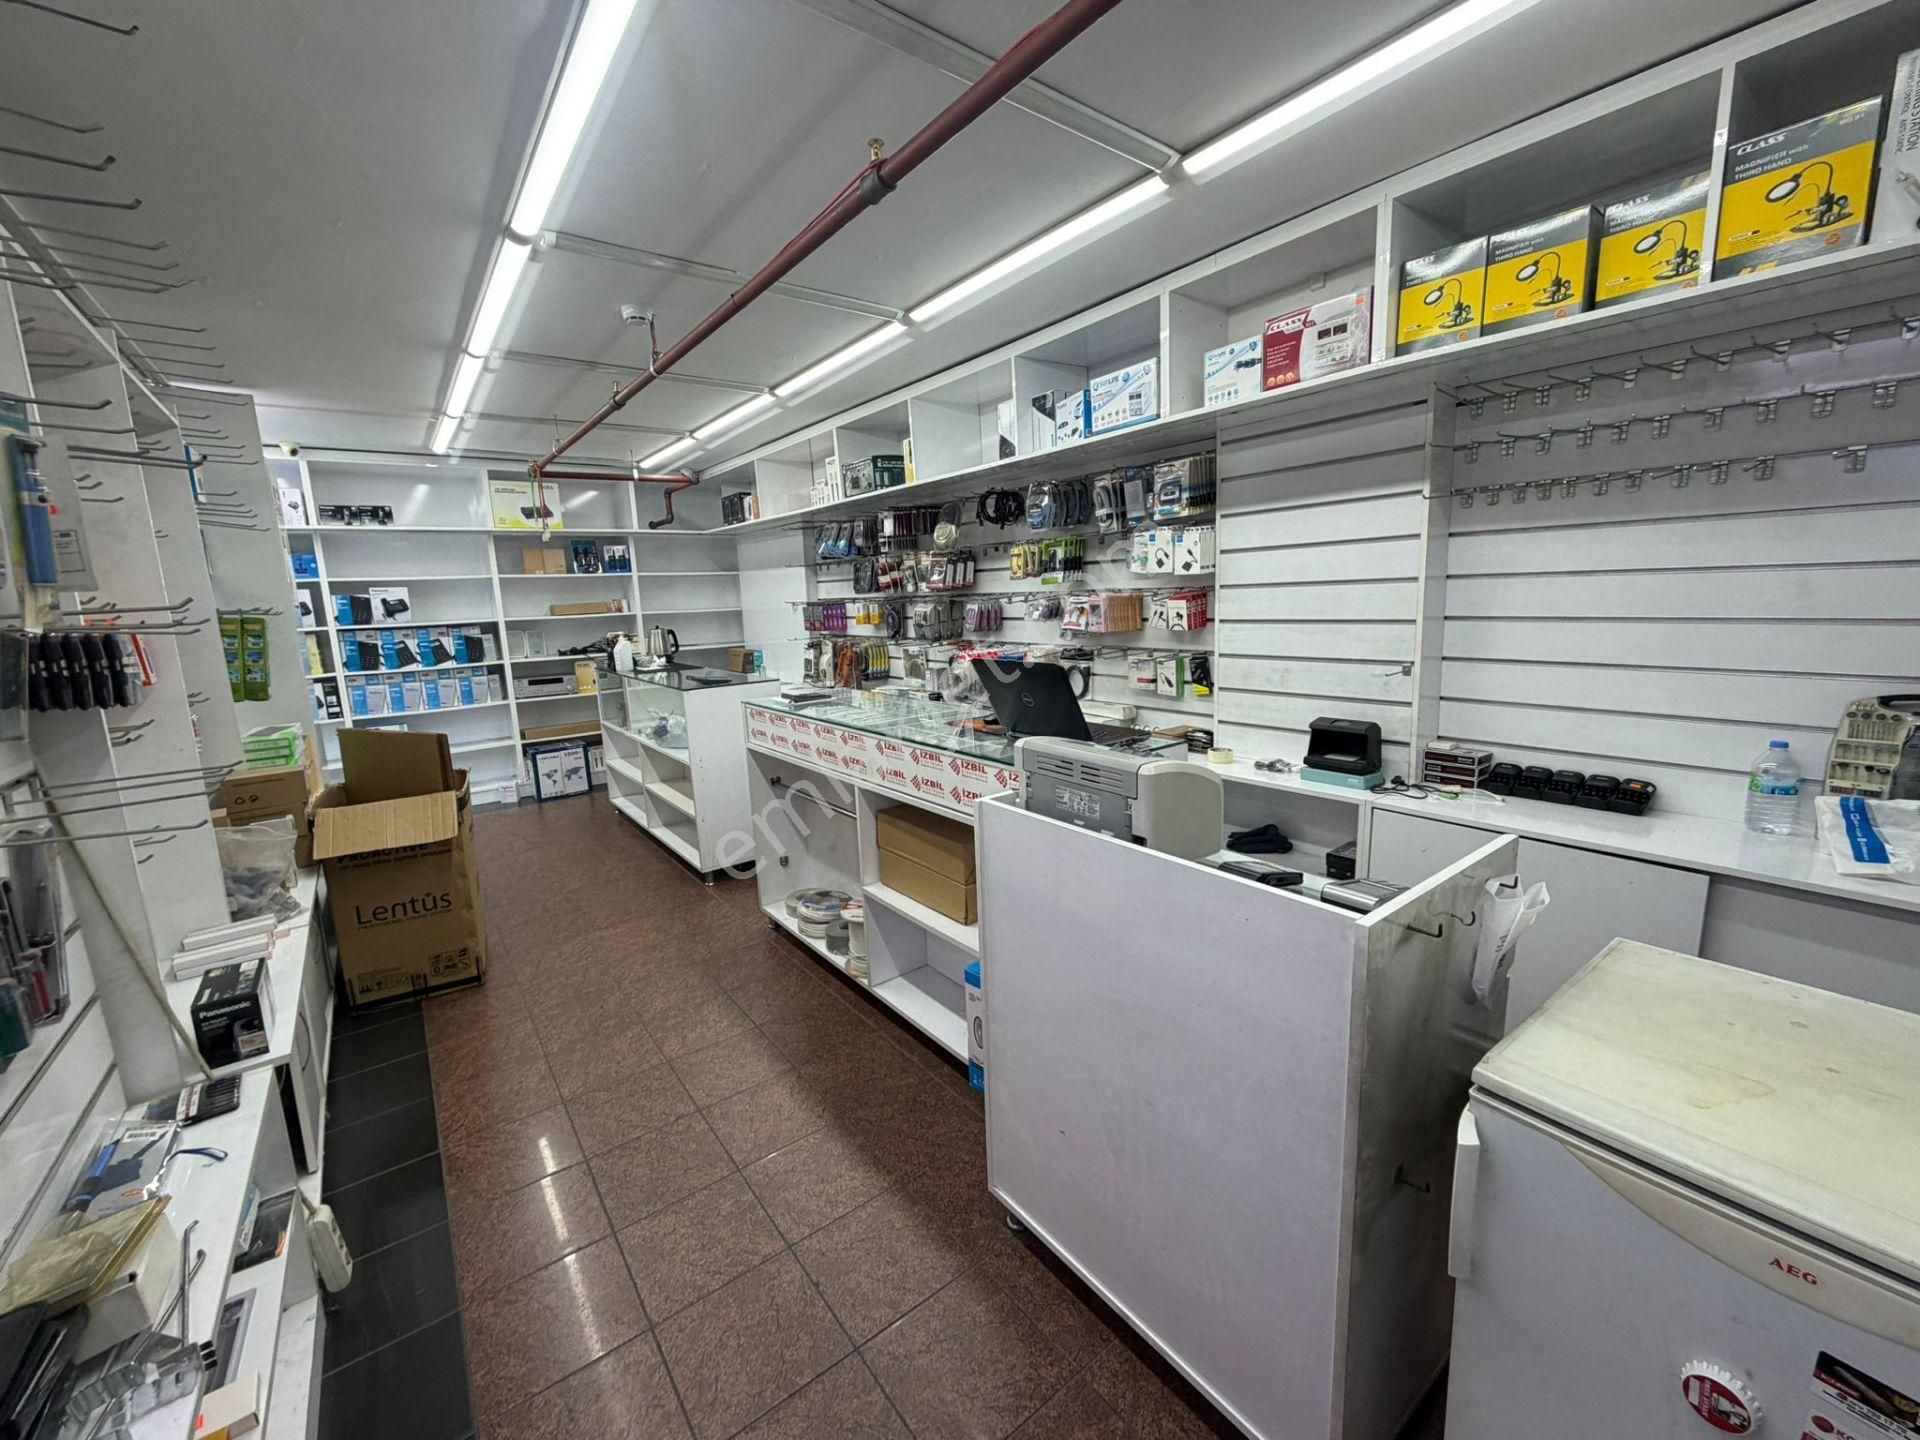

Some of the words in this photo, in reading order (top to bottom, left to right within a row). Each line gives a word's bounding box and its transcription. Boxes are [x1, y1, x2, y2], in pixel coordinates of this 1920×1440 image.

[1736, 132, 1788, 156] CLASS
[1735, 150, 1787, 173] MAGNIFIER
[1788, 144, 1809, 156] with
[1735, 168, 1762, 180] THIRD
[1763, 158, 1792, 173] HAND
[1495, 241, 1530, 255] MAGNIFIER
[199, 1001, 252, 1019] Panasonic
[1769, 1257, 1819, 1286] AEG
